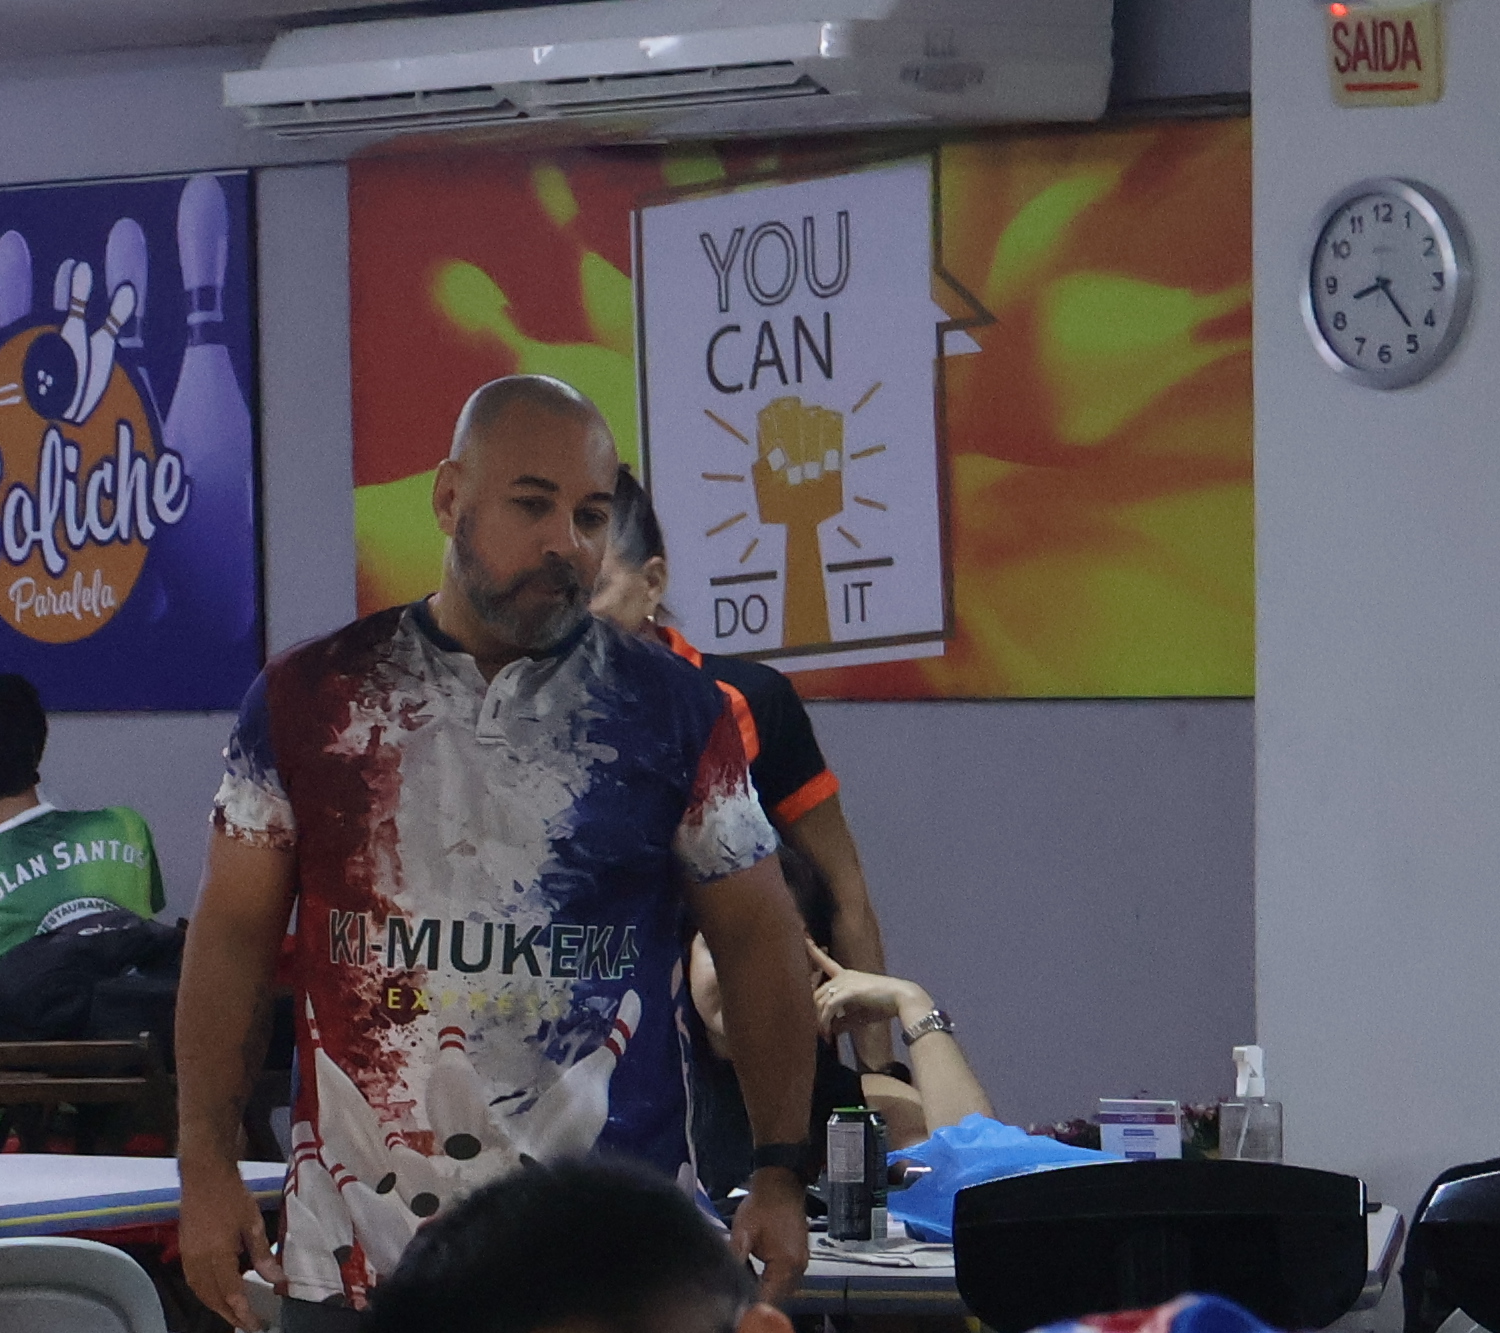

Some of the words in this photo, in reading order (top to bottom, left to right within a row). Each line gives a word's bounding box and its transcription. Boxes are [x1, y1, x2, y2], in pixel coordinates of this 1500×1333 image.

[1332, 18, 1422, 74] SAIDA
[1373, 203, 1393, 223] 12
[1404, 210, 1412, 229] 1
[1350, 215, 1364, 234] 11
[1331, 239, 1351, 260] 10
[1422, 237, 1436, 257] 2
[700, 209, 851, 313] YOU
[1325, 276, 1338, 295] 9
[1332, 311, 1348, 332] 8
[1424, 308, 1436, 328] 4
[706, 311, 833, 394] CAN
[1354, 337, 1366, 356] 7
[1377, 344, 1392, 364] 6
[1406, 333, 1420, 355] 5
[8, 568, 119, 623] Paralela
[714, 594, 769, 638] DO
[843, 581, 873, 624] IT
[52, 839, 146, 871] SANTOS
[328, 908, 642, 981] KI-MUKEKA
